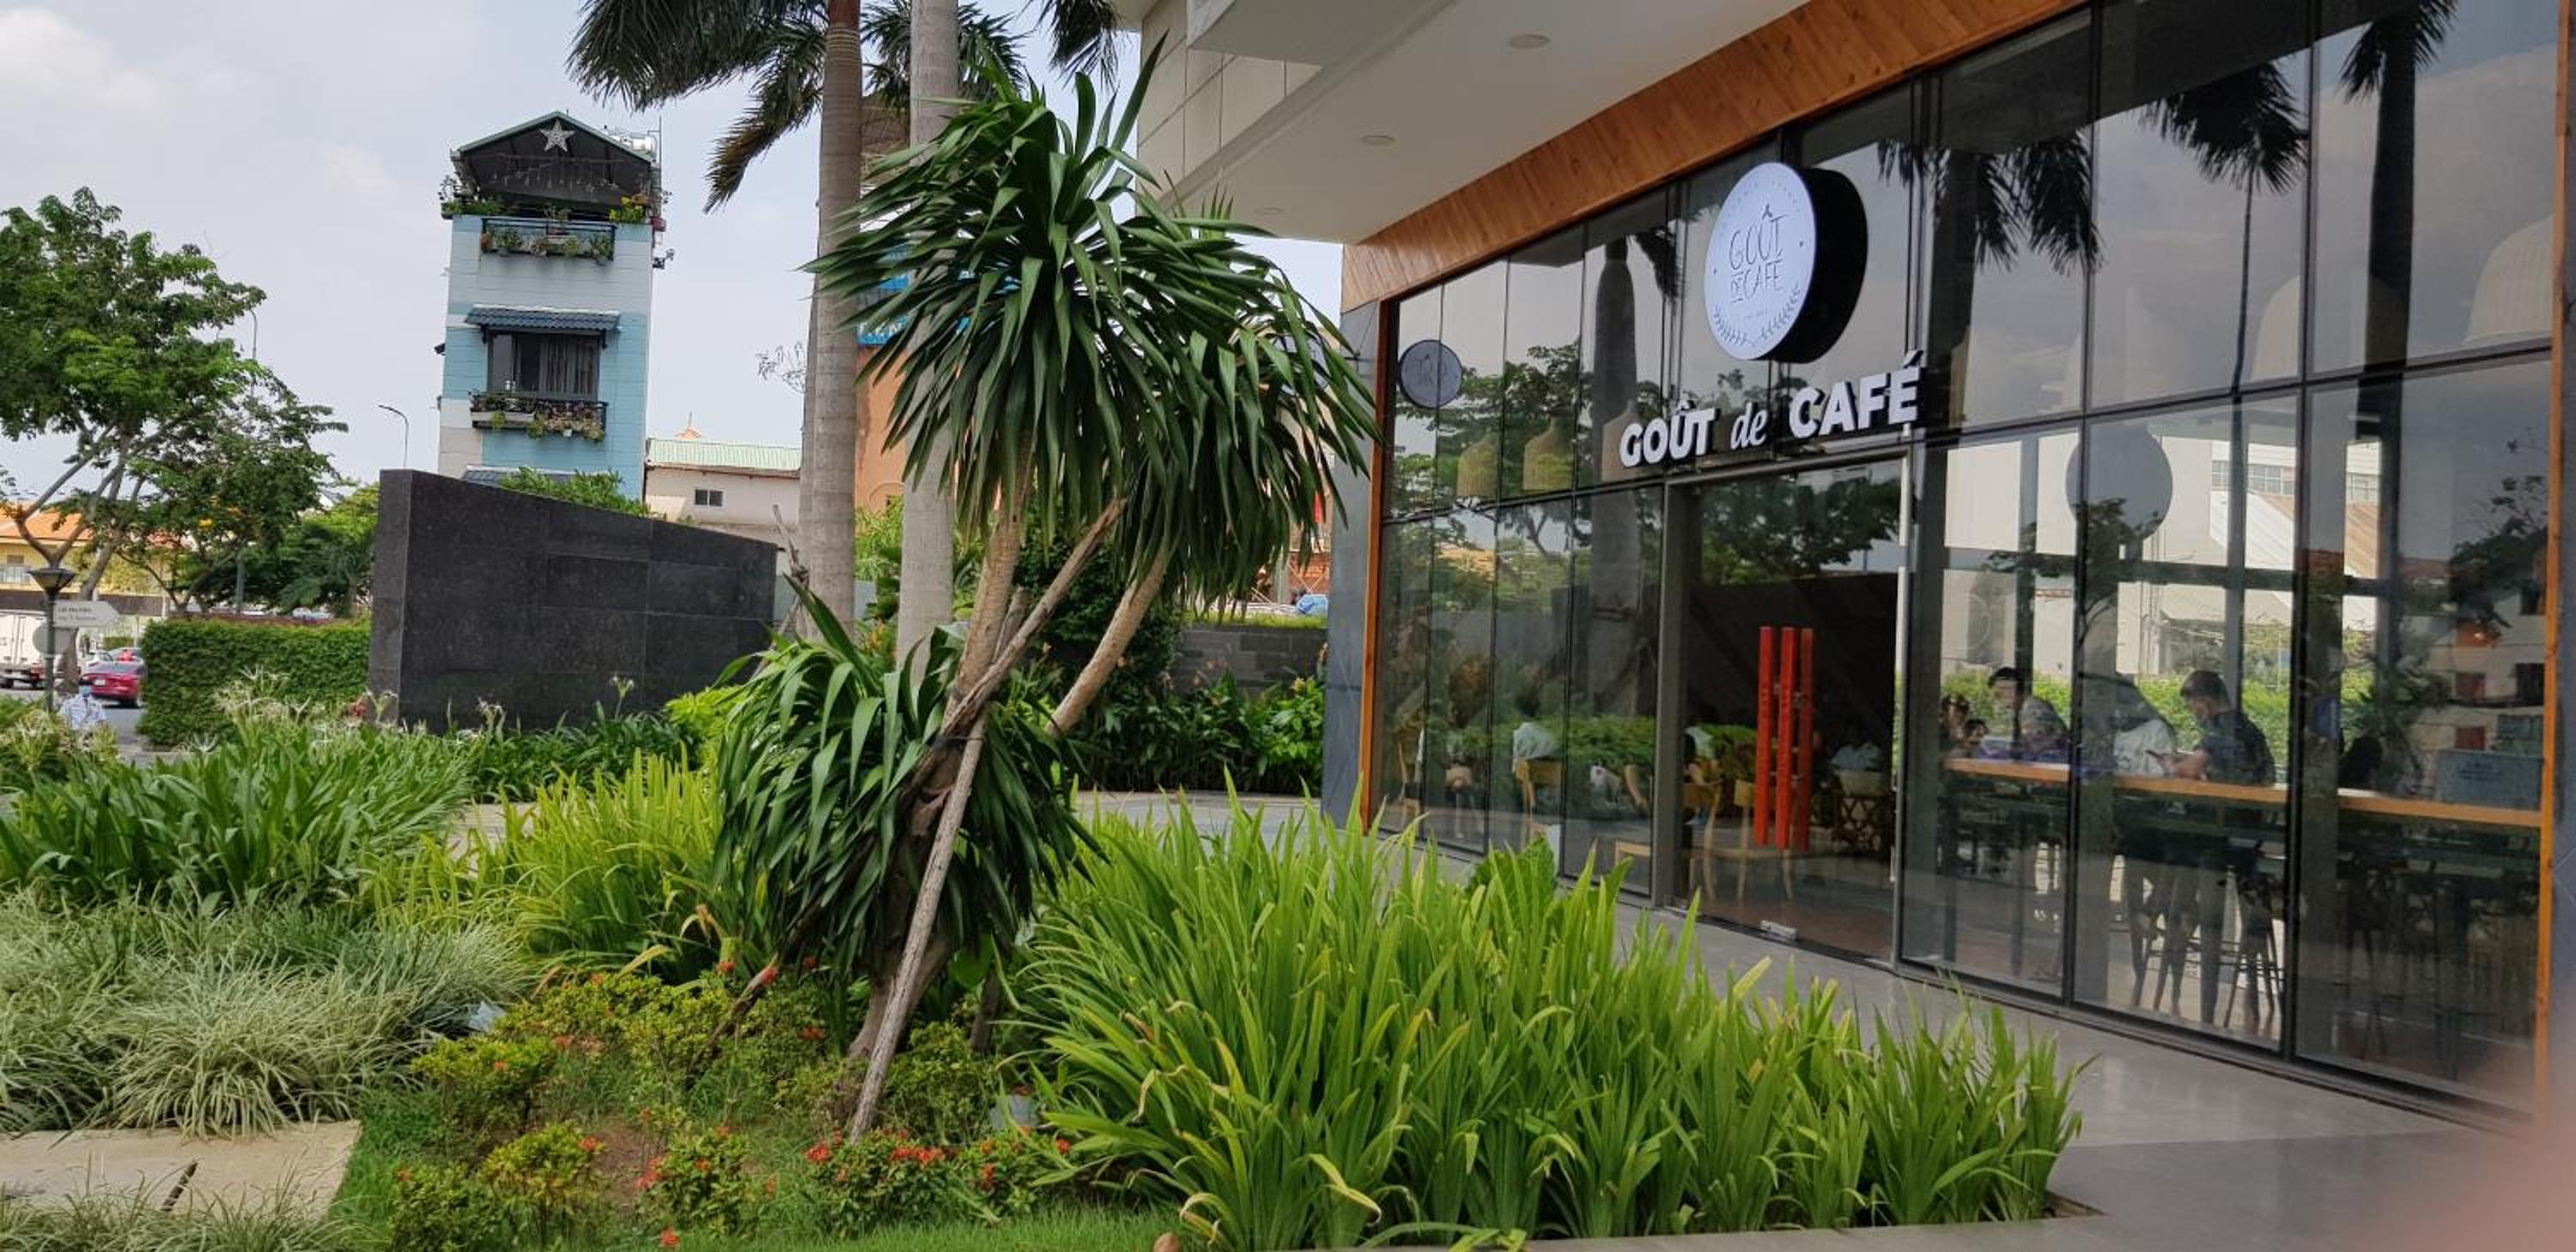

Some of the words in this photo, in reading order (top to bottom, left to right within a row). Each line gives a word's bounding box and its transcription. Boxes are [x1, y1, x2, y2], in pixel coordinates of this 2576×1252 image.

[1619, 400, 1716, 467] GOÛT
[1730, 402, 1768, 450] de
[1789, 349, 1924, 439] CAFÉ
